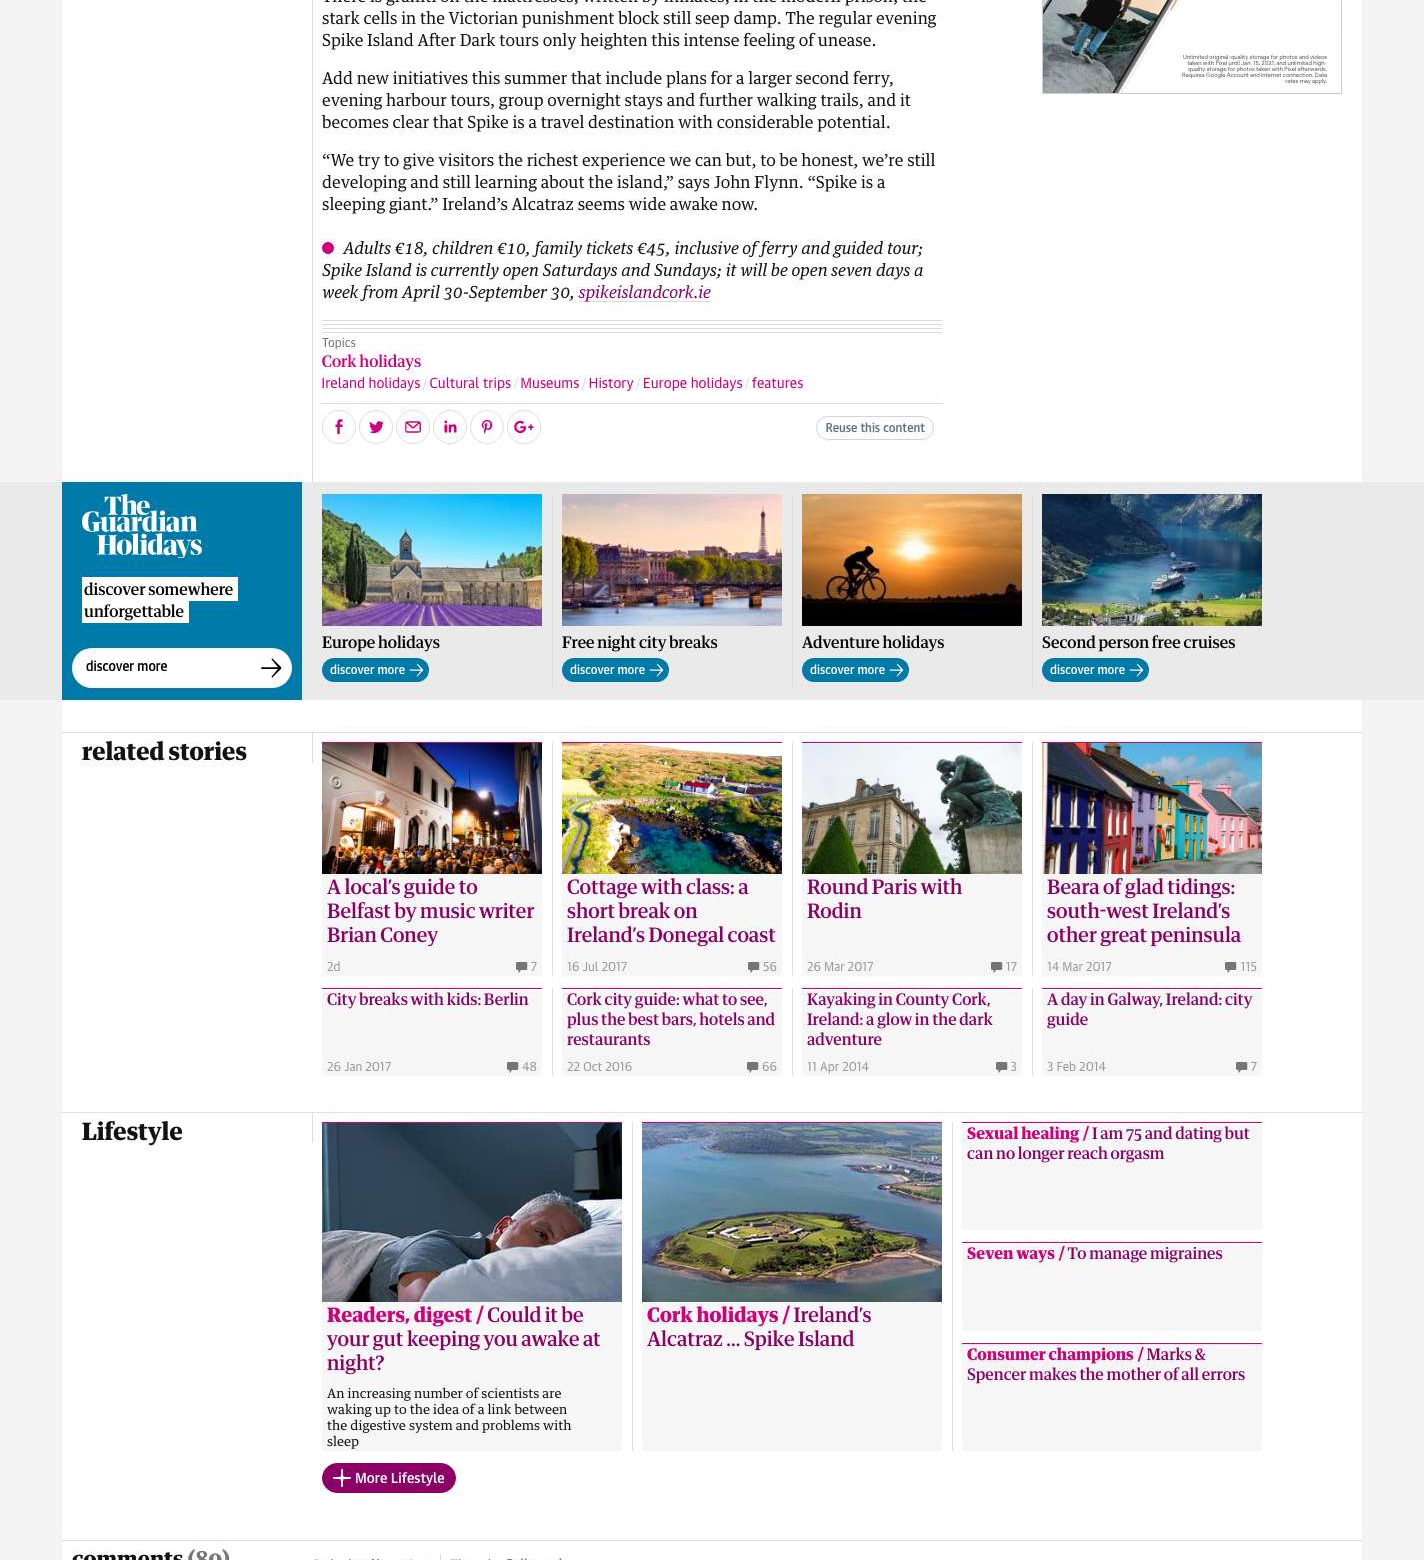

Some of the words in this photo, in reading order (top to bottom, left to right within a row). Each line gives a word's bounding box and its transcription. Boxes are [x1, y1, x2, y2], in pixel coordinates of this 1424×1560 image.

[321, 338, 356, 350] Topics
[103, 493, 150, 516] The
[81, 510, 197, 533] Guardian
[96, 533, 203, 558] Holidays
[83, 582, 146, 596] discover
[147, 582, 233, 596] somewhere
[83, 604, 184, 621] unforgettable
[321, 636, 375, 652] Europe
[377, 635, 440, 652] holidays
[81, 741, 164, 761] related
[168, 741, 247, 761] stories
[806, 878, 868, 895] Round
[871, 879, 917, 895] Paris
[920, 878, 962, 894] with
[806, 902, 862, 919] Rodin
[807, 962, 820, 971] 26
[825, 962, 845, 971] Mar
[848, 962, 873, 971] 2017
[1006, 962, 1017, 971] 17
[81, 1121, 182, 1146] Lifestyle
